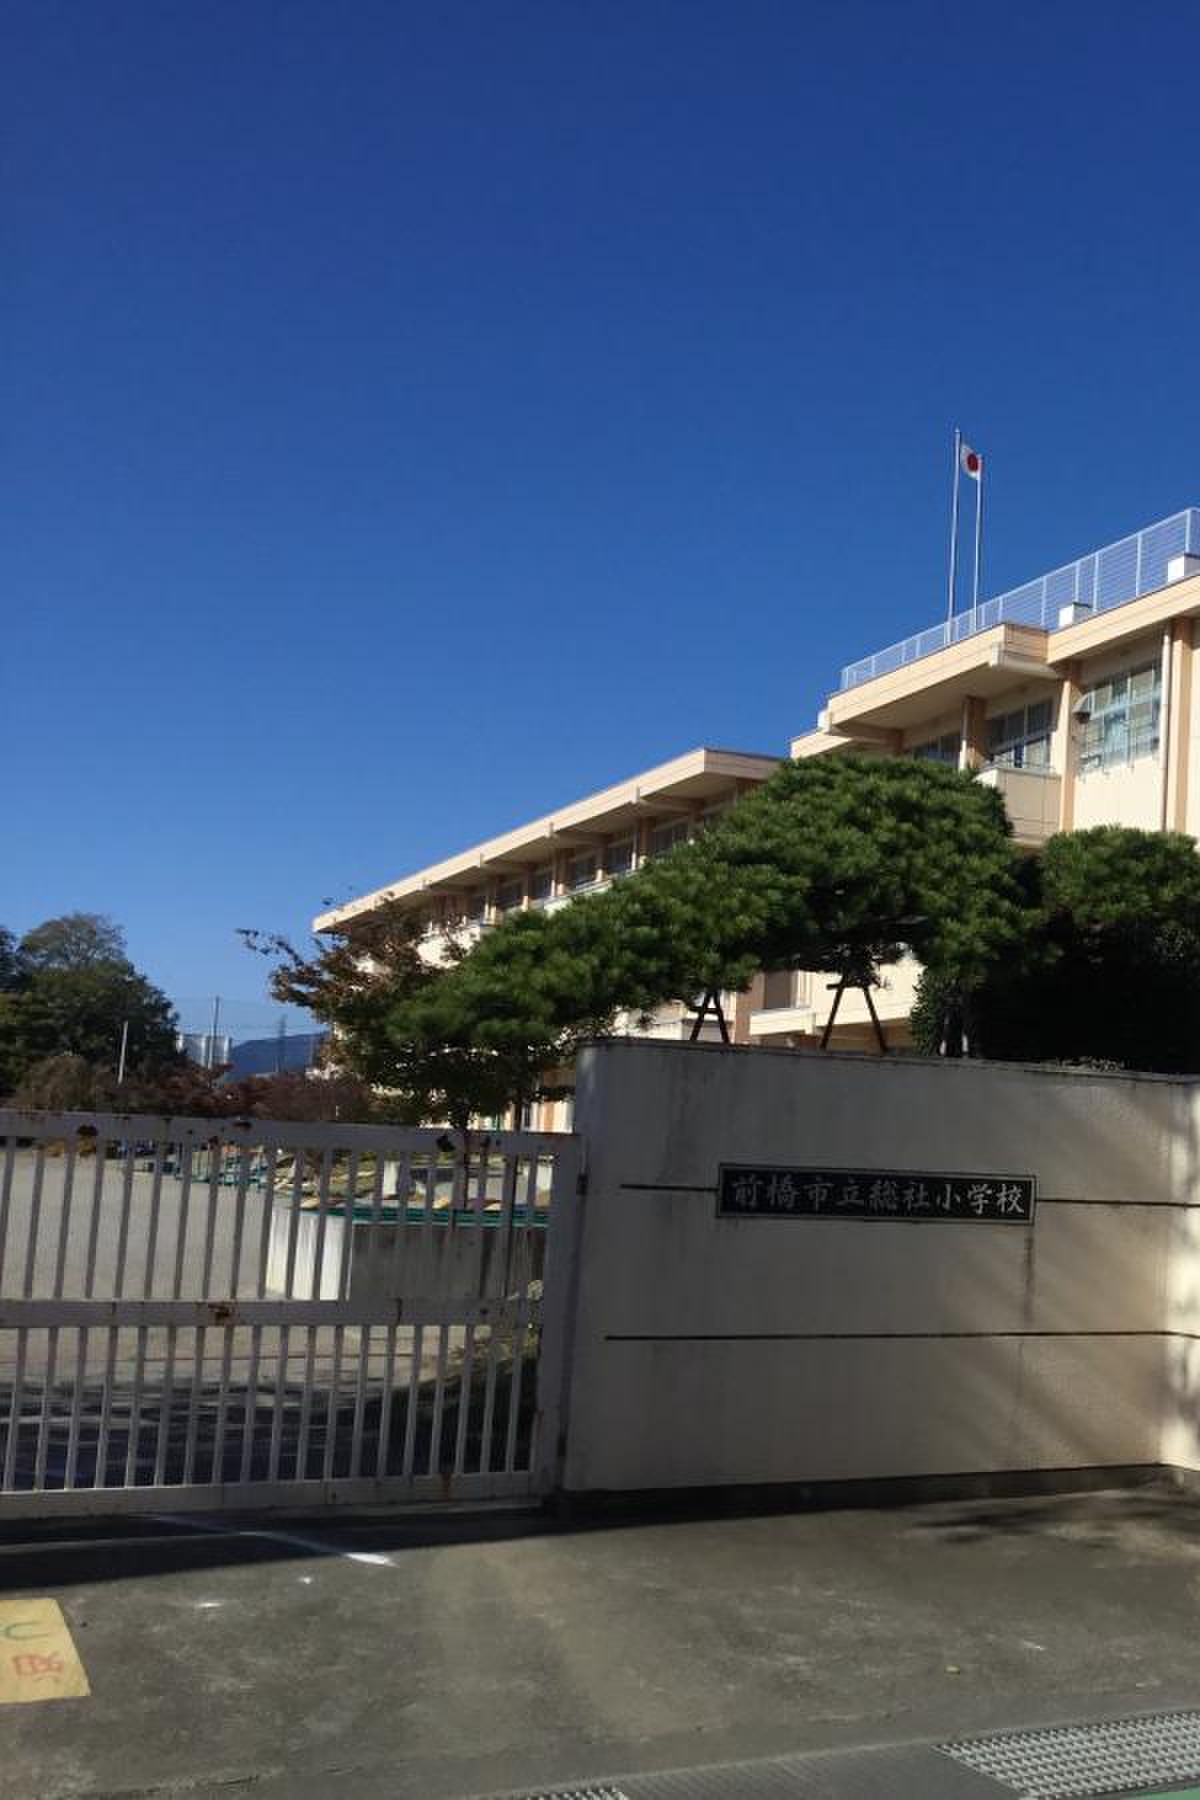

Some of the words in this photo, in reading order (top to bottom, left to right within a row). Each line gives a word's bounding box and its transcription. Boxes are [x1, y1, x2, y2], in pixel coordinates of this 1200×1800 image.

[731, 1173, 1026, 1215] 前橋市立総社小学校
